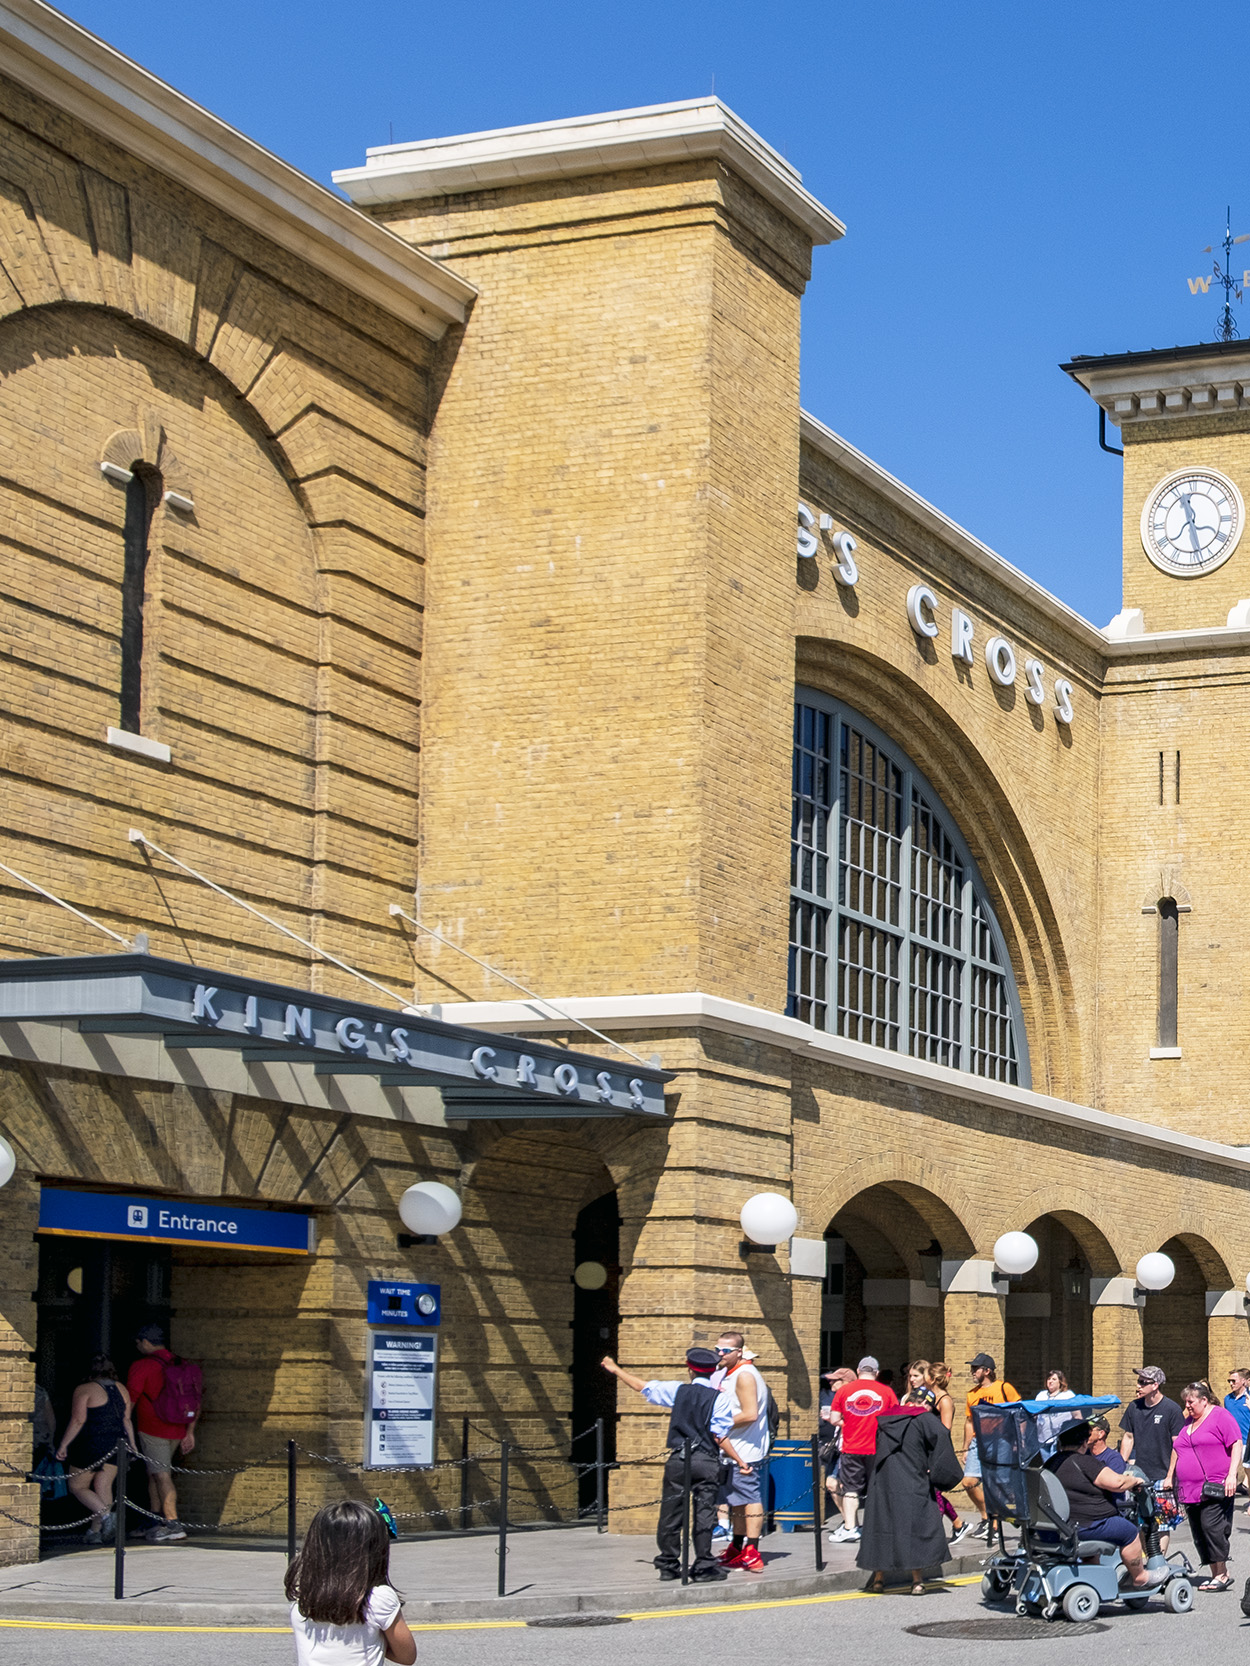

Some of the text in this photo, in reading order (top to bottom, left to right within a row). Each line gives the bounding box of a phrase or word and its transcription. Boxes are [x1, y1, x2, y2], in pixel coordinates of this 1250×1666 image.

[1187, 275, 1212, 295] W
[906, 584, 1074, 724] CROSS
[191, 984, 643, 1106] KING'S CROSS
[158, 1210, 238, 1235] Entrance
[379, 1287, 411, 1296] WAIT TIME
[385, 1341, 422, 1349] WARNING!
